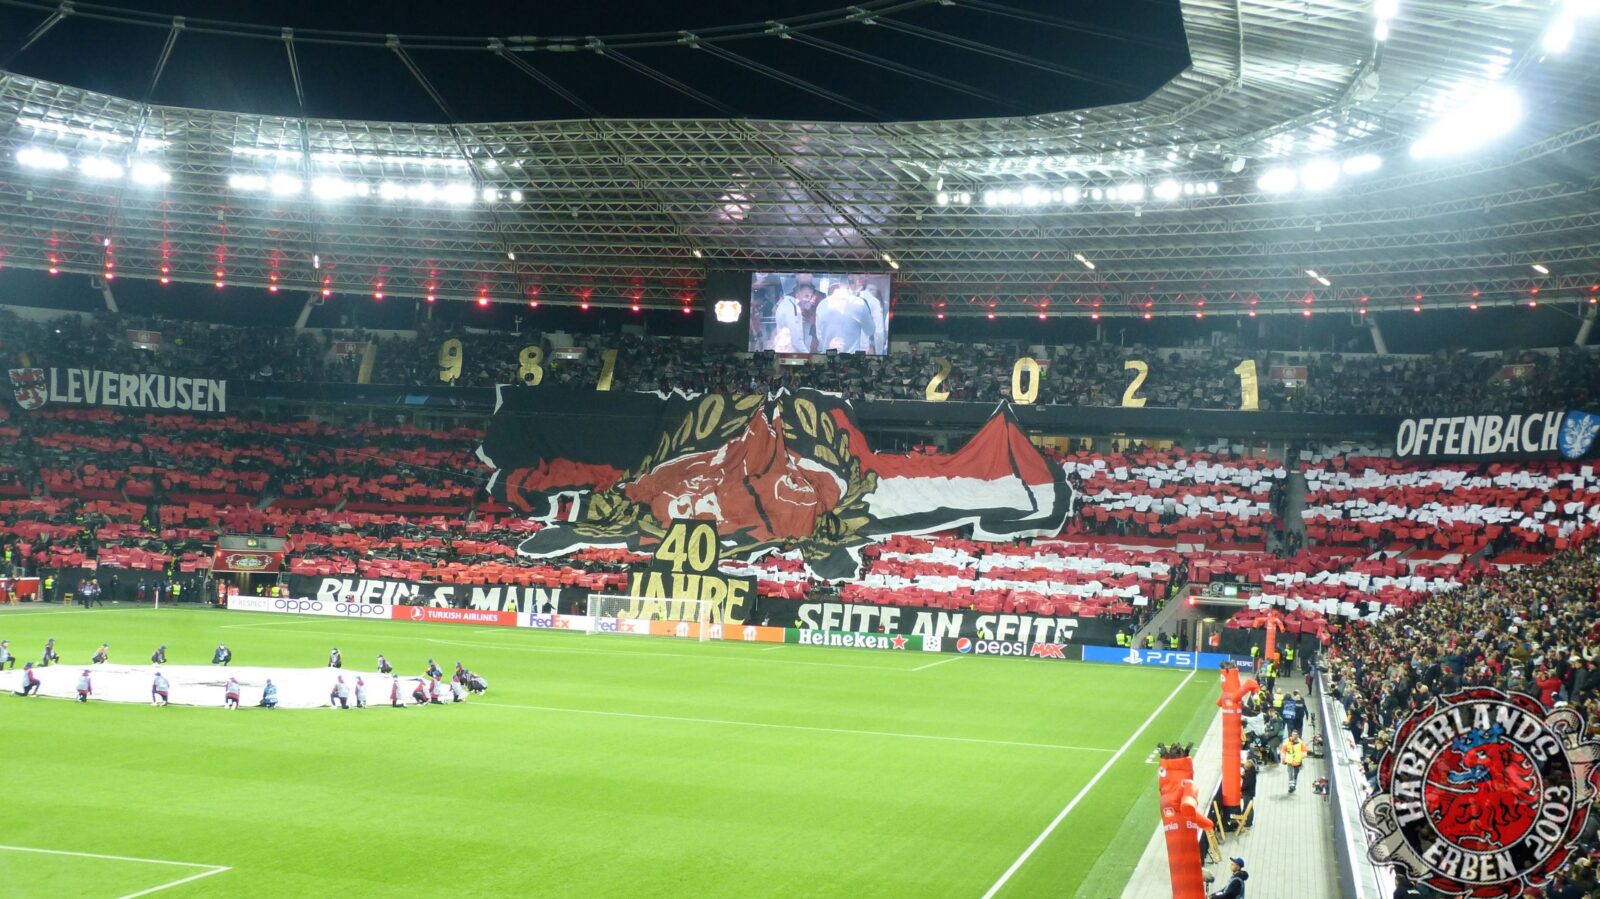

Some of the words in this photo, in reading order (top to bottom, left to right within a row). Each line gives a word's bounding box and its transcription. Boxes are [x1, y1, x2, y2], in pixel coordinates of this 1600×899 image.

[50, 367, 227, 412] LEVERKUSEN
[1396, 411, 1566, 457] OFFENBACH
[656, 523, 717, 573] 40
[274, 599, 323, 613] oppo
[317, 577, 420, 606] RHEIN
[470, 586, 562, 615] MAIN
[617, 572, 750, 626] JAHRE
[335, 602, 385, 616] oppo
[428, 611, 462, 621] TURKISH
[463, 613, 498, 622] AIRLINES
[529, 613, 570, 629] FedEx
[798, 602, 901, 634] SEITE
[911, 611, 964, 638] AN
[975, 615, 1079, 645] SEITE
[798, 628, 889, 649] Heineken
[975, 640, 1027, 656] pepsi
[1030, 642, 1068, 659] MAX
[1146, 652, 1191, 665] PS5
